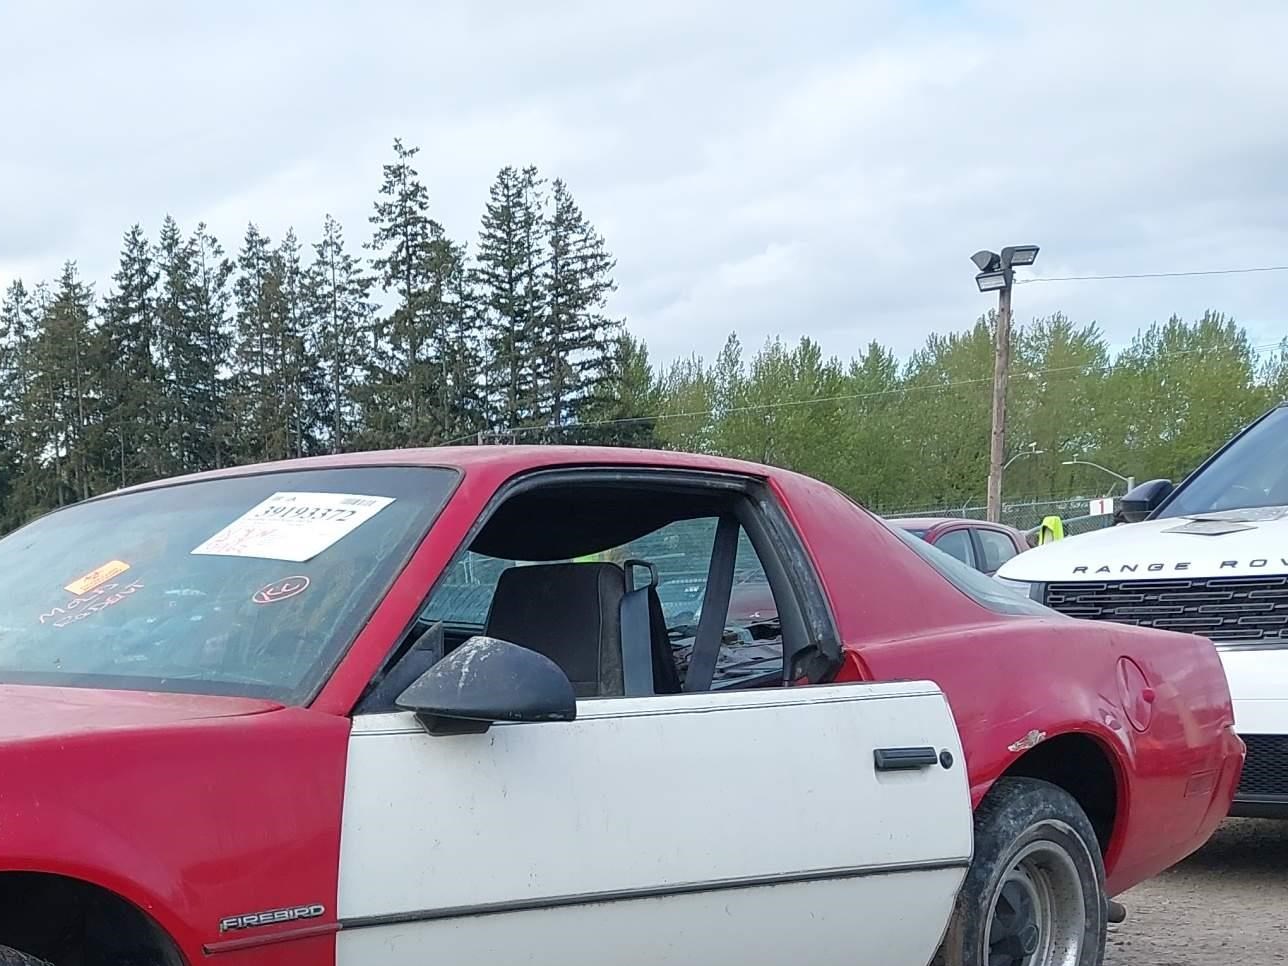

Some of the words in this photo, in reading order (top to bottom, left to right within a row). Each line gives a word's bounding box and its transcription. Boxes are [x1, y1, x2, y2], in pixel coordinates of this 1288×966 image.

[254, 505, 357, 522] 39193372
[1072, 562, 1192, 574] RANGE
[221, 905, 325, 931] FIREBIRD
